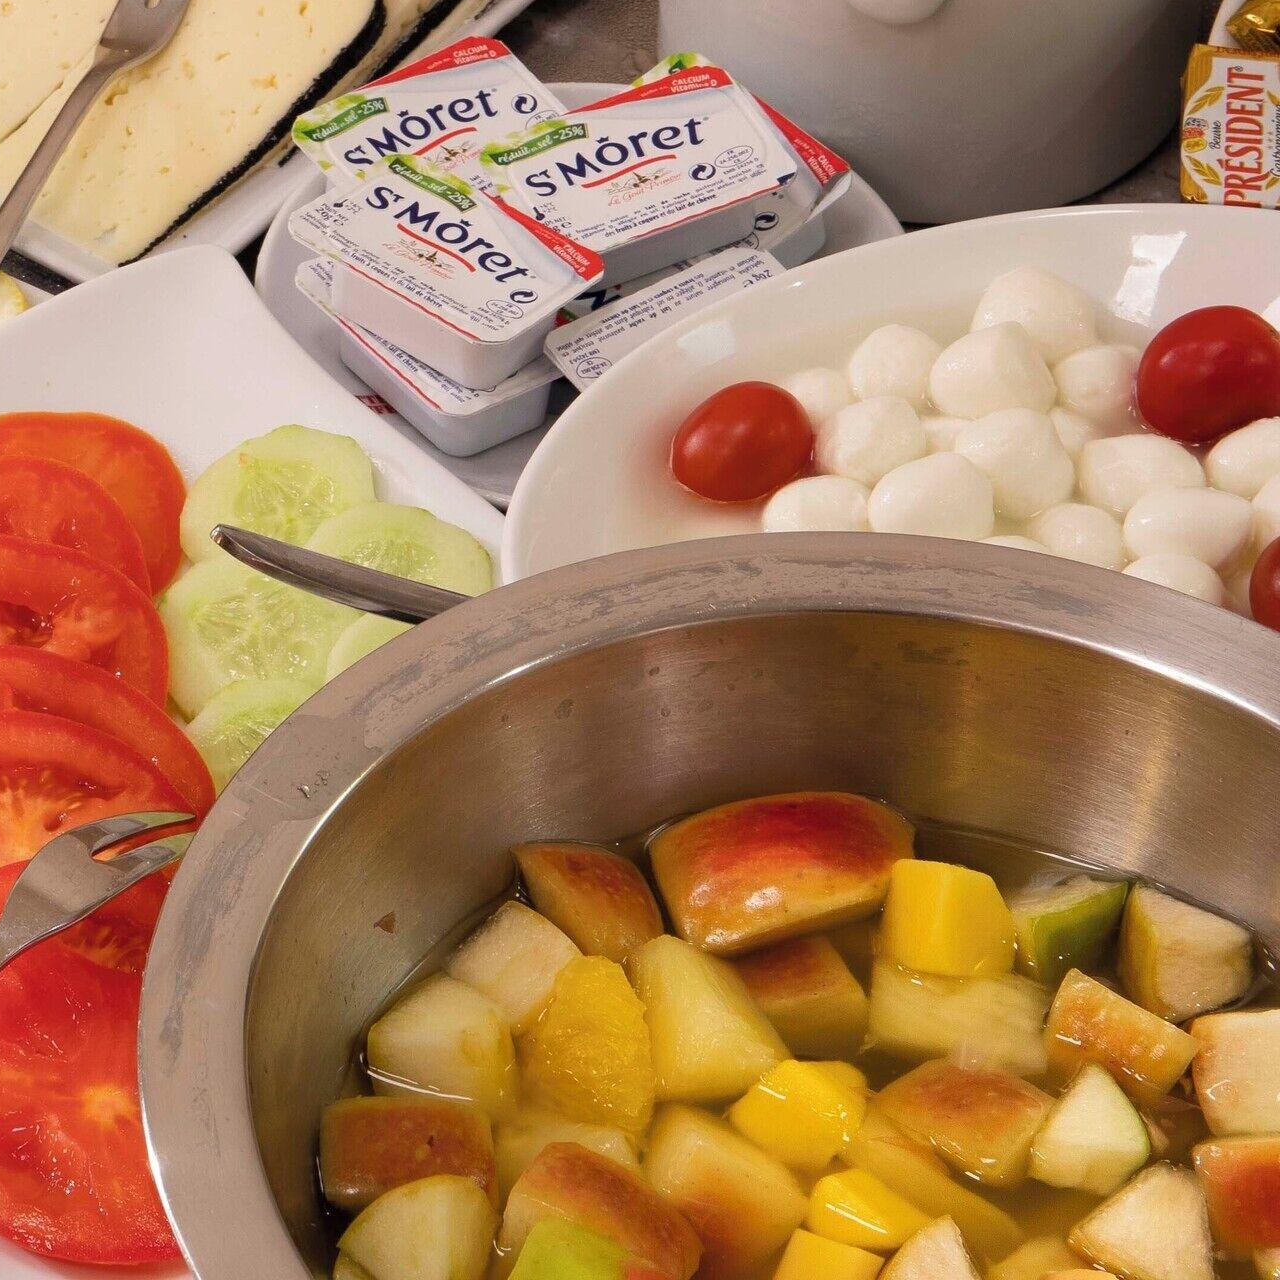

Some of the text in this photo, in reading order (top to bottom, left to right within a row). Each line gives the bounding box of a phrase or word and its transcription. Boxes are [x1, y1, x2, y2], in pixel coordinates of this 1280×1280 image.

[452, 44, 489, 59] CALCIUM
[670, 73, 711, 87] CALCIUM
[311, 99, 385, 140] réduit sel -25%
[497, 125, 585, 163] réduit sel -25%
[1216, 65, 1271, 208] PRÉSIDENT
[391, 160, 474, 212] réduit sel -25%
[563, 243, 591, 268] CALCIUM
[628, 317, 646, 329] vache
